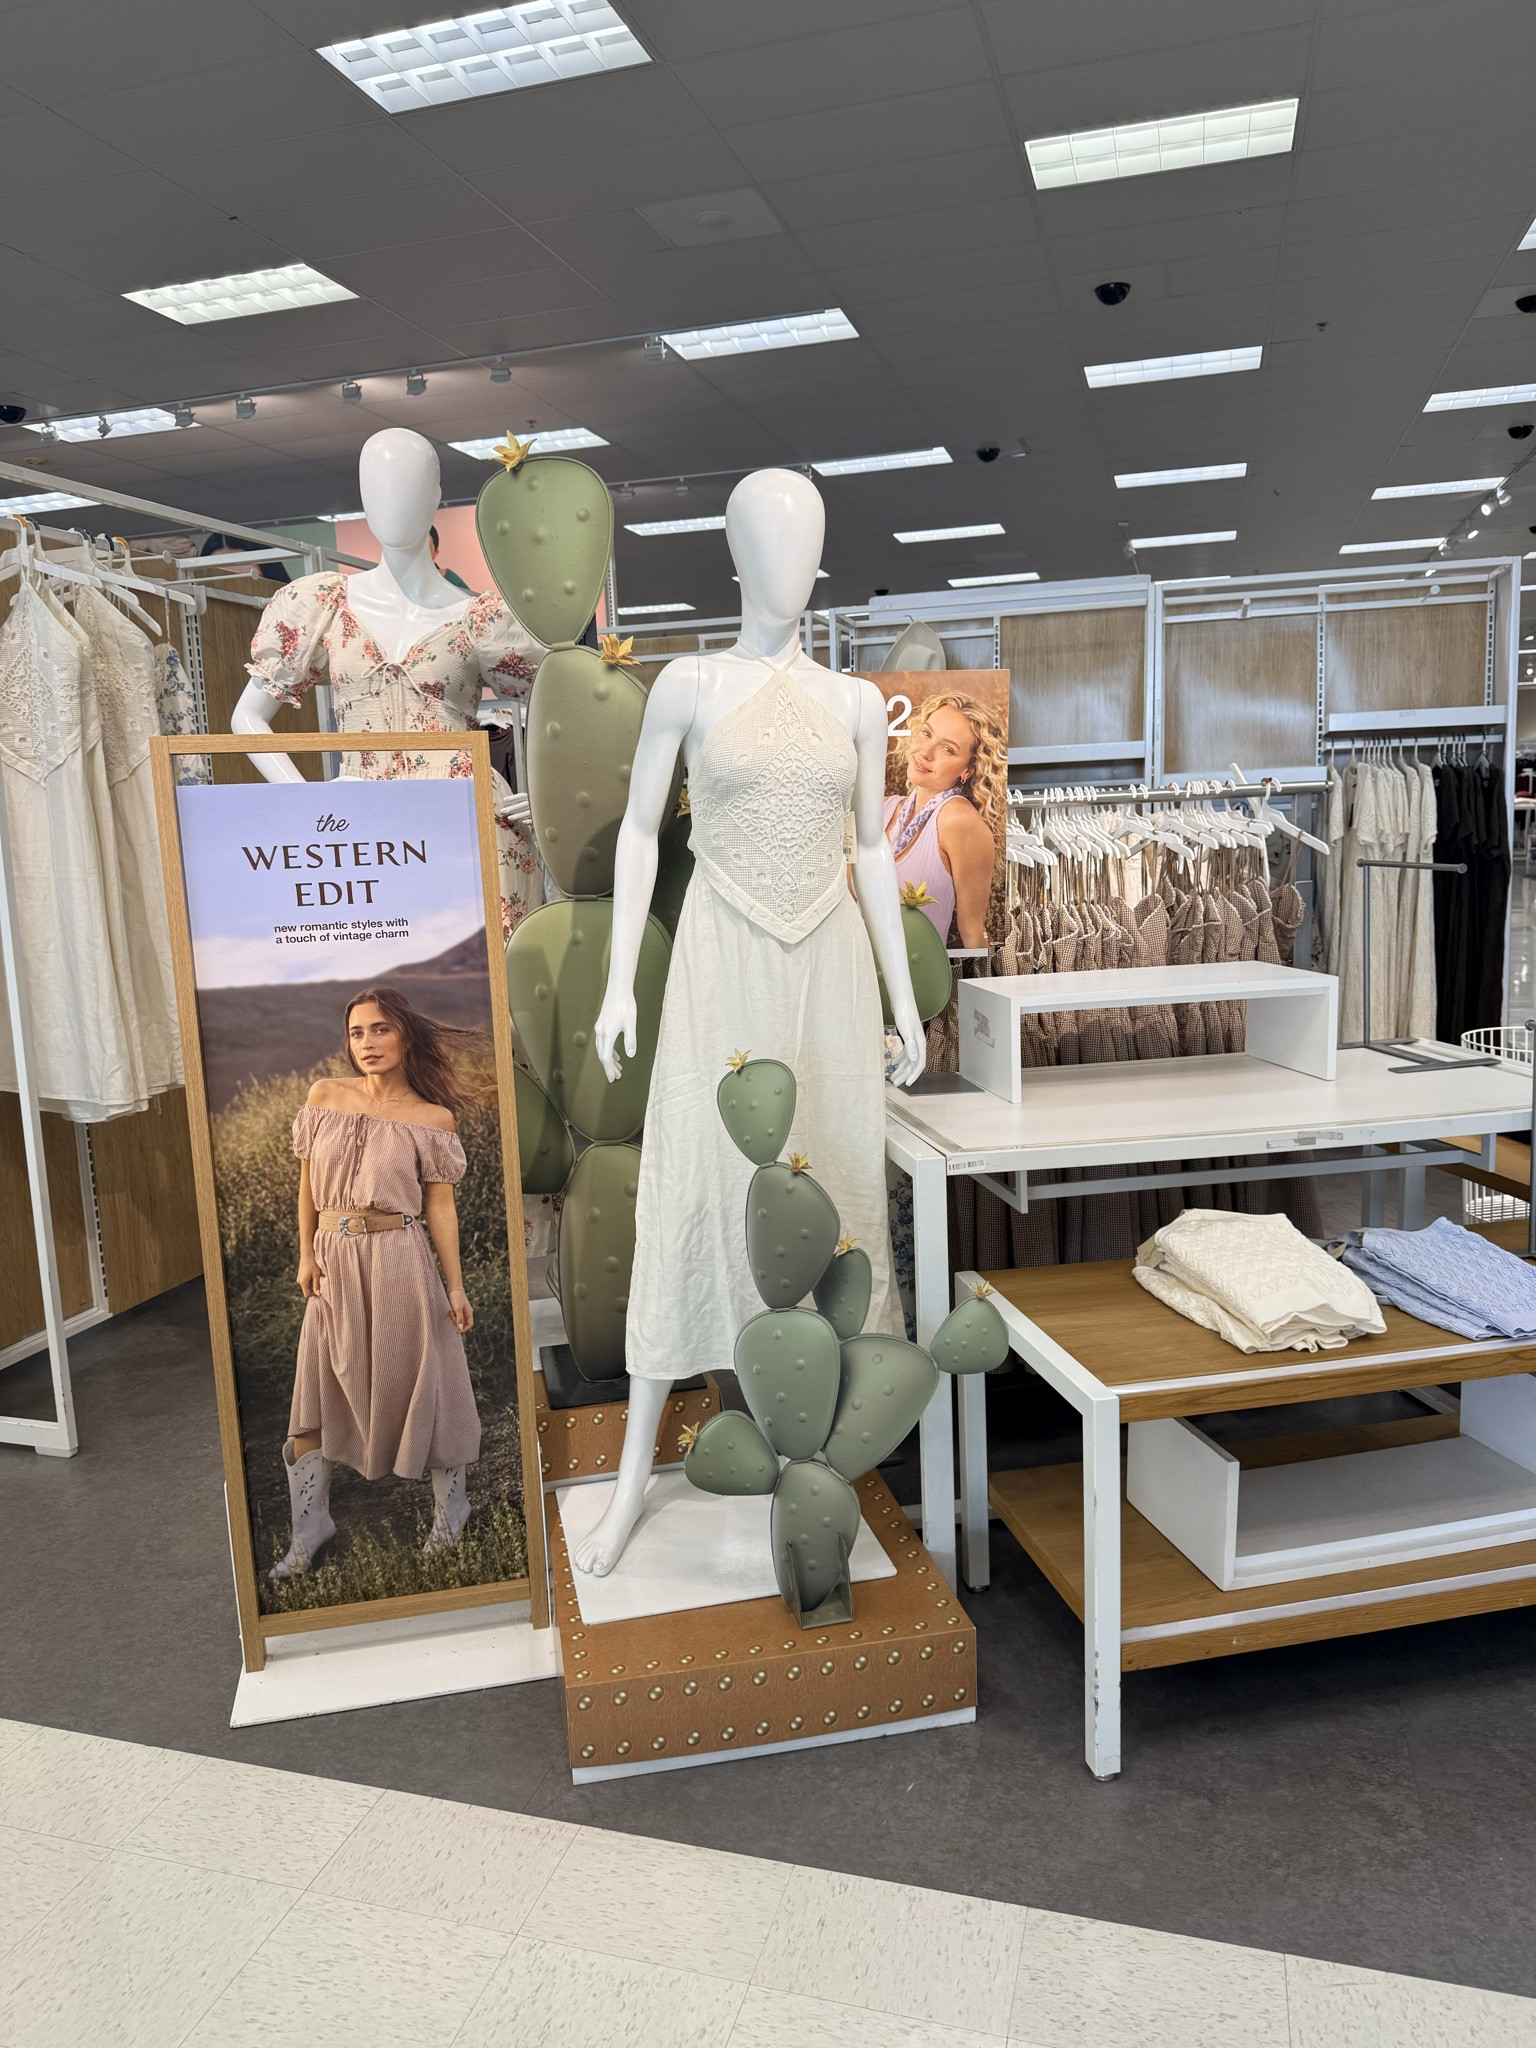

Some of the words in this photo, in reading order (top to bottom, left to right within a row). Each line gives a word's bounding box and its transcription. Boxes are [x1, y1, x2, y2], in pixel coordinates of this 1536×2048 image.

[316, 813, 350, 833] the
[241, 840, 427, 871] WESTERN
[295, 879, 380, 907] EDIT
[274, 924, 297, 933] new
[300, 920, 348, 932] romantic
[351, 919, 383, 930] styles
[385, 917, 409, 928] with
[275, 936, 283, 944] a
[285, 933, 317, 944] touch
[319, 932, 330, 942] of
[333, 931, 373, 942] vintage
[375, 929, 409, 939] charm
